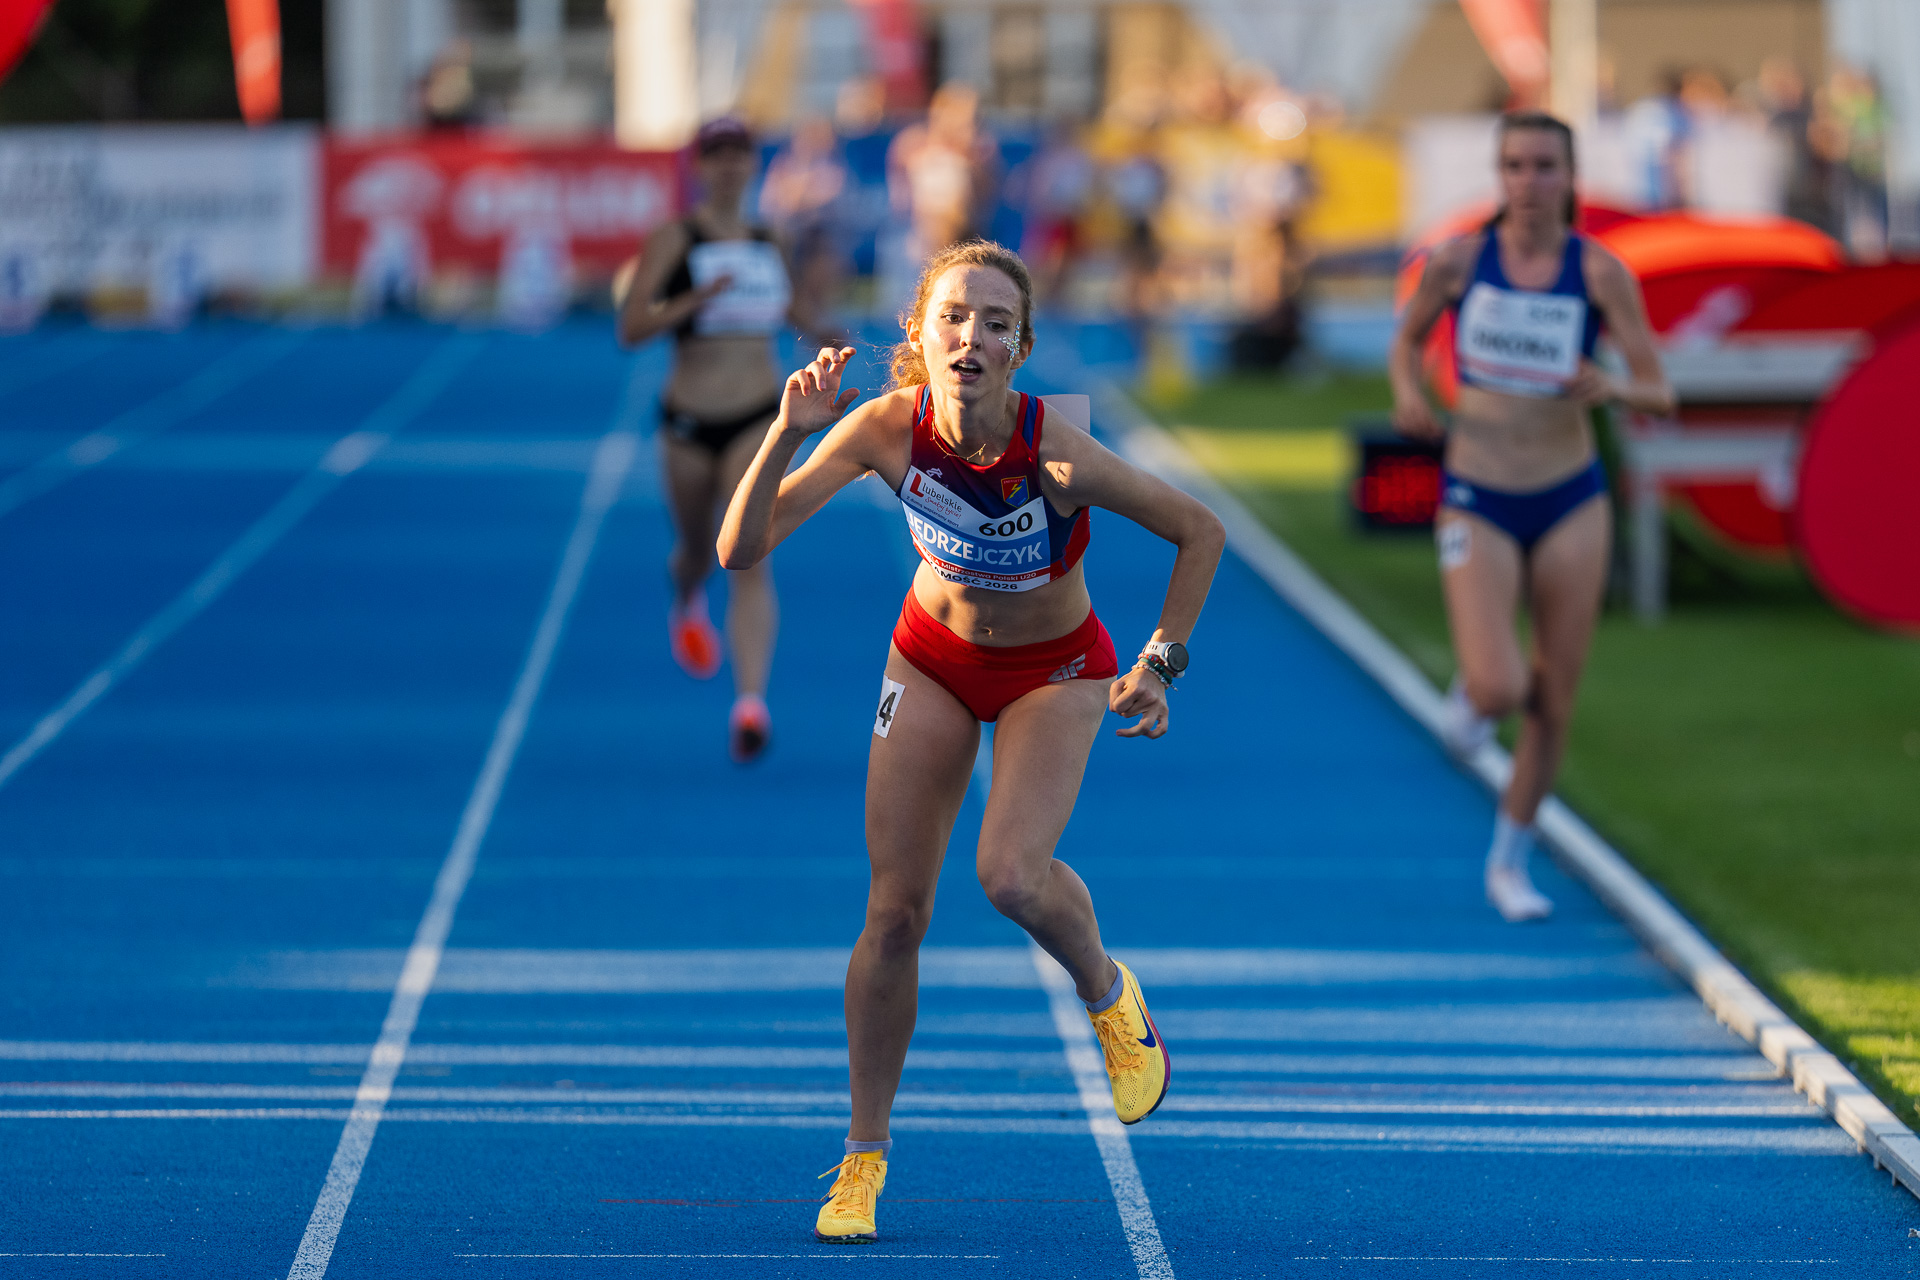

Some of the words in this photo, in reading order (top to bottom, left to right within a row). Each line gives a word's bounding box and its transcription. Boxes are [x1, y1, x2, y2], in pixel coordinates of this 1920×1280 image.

[908, 511, 1043, 566] JĘDRZEJCZYK
[978, 511, 1034, 537] 600
[931, 561, 981, 585] AMOŚĆ
[984, 581, 1018, 590] 2026
[941, 562, 991, 579] Mistrzostwa
[993, 573, 1018, 581] Polski
[1020, 571, 1037, 580] U20
[878, 691, 897, 728] 4
